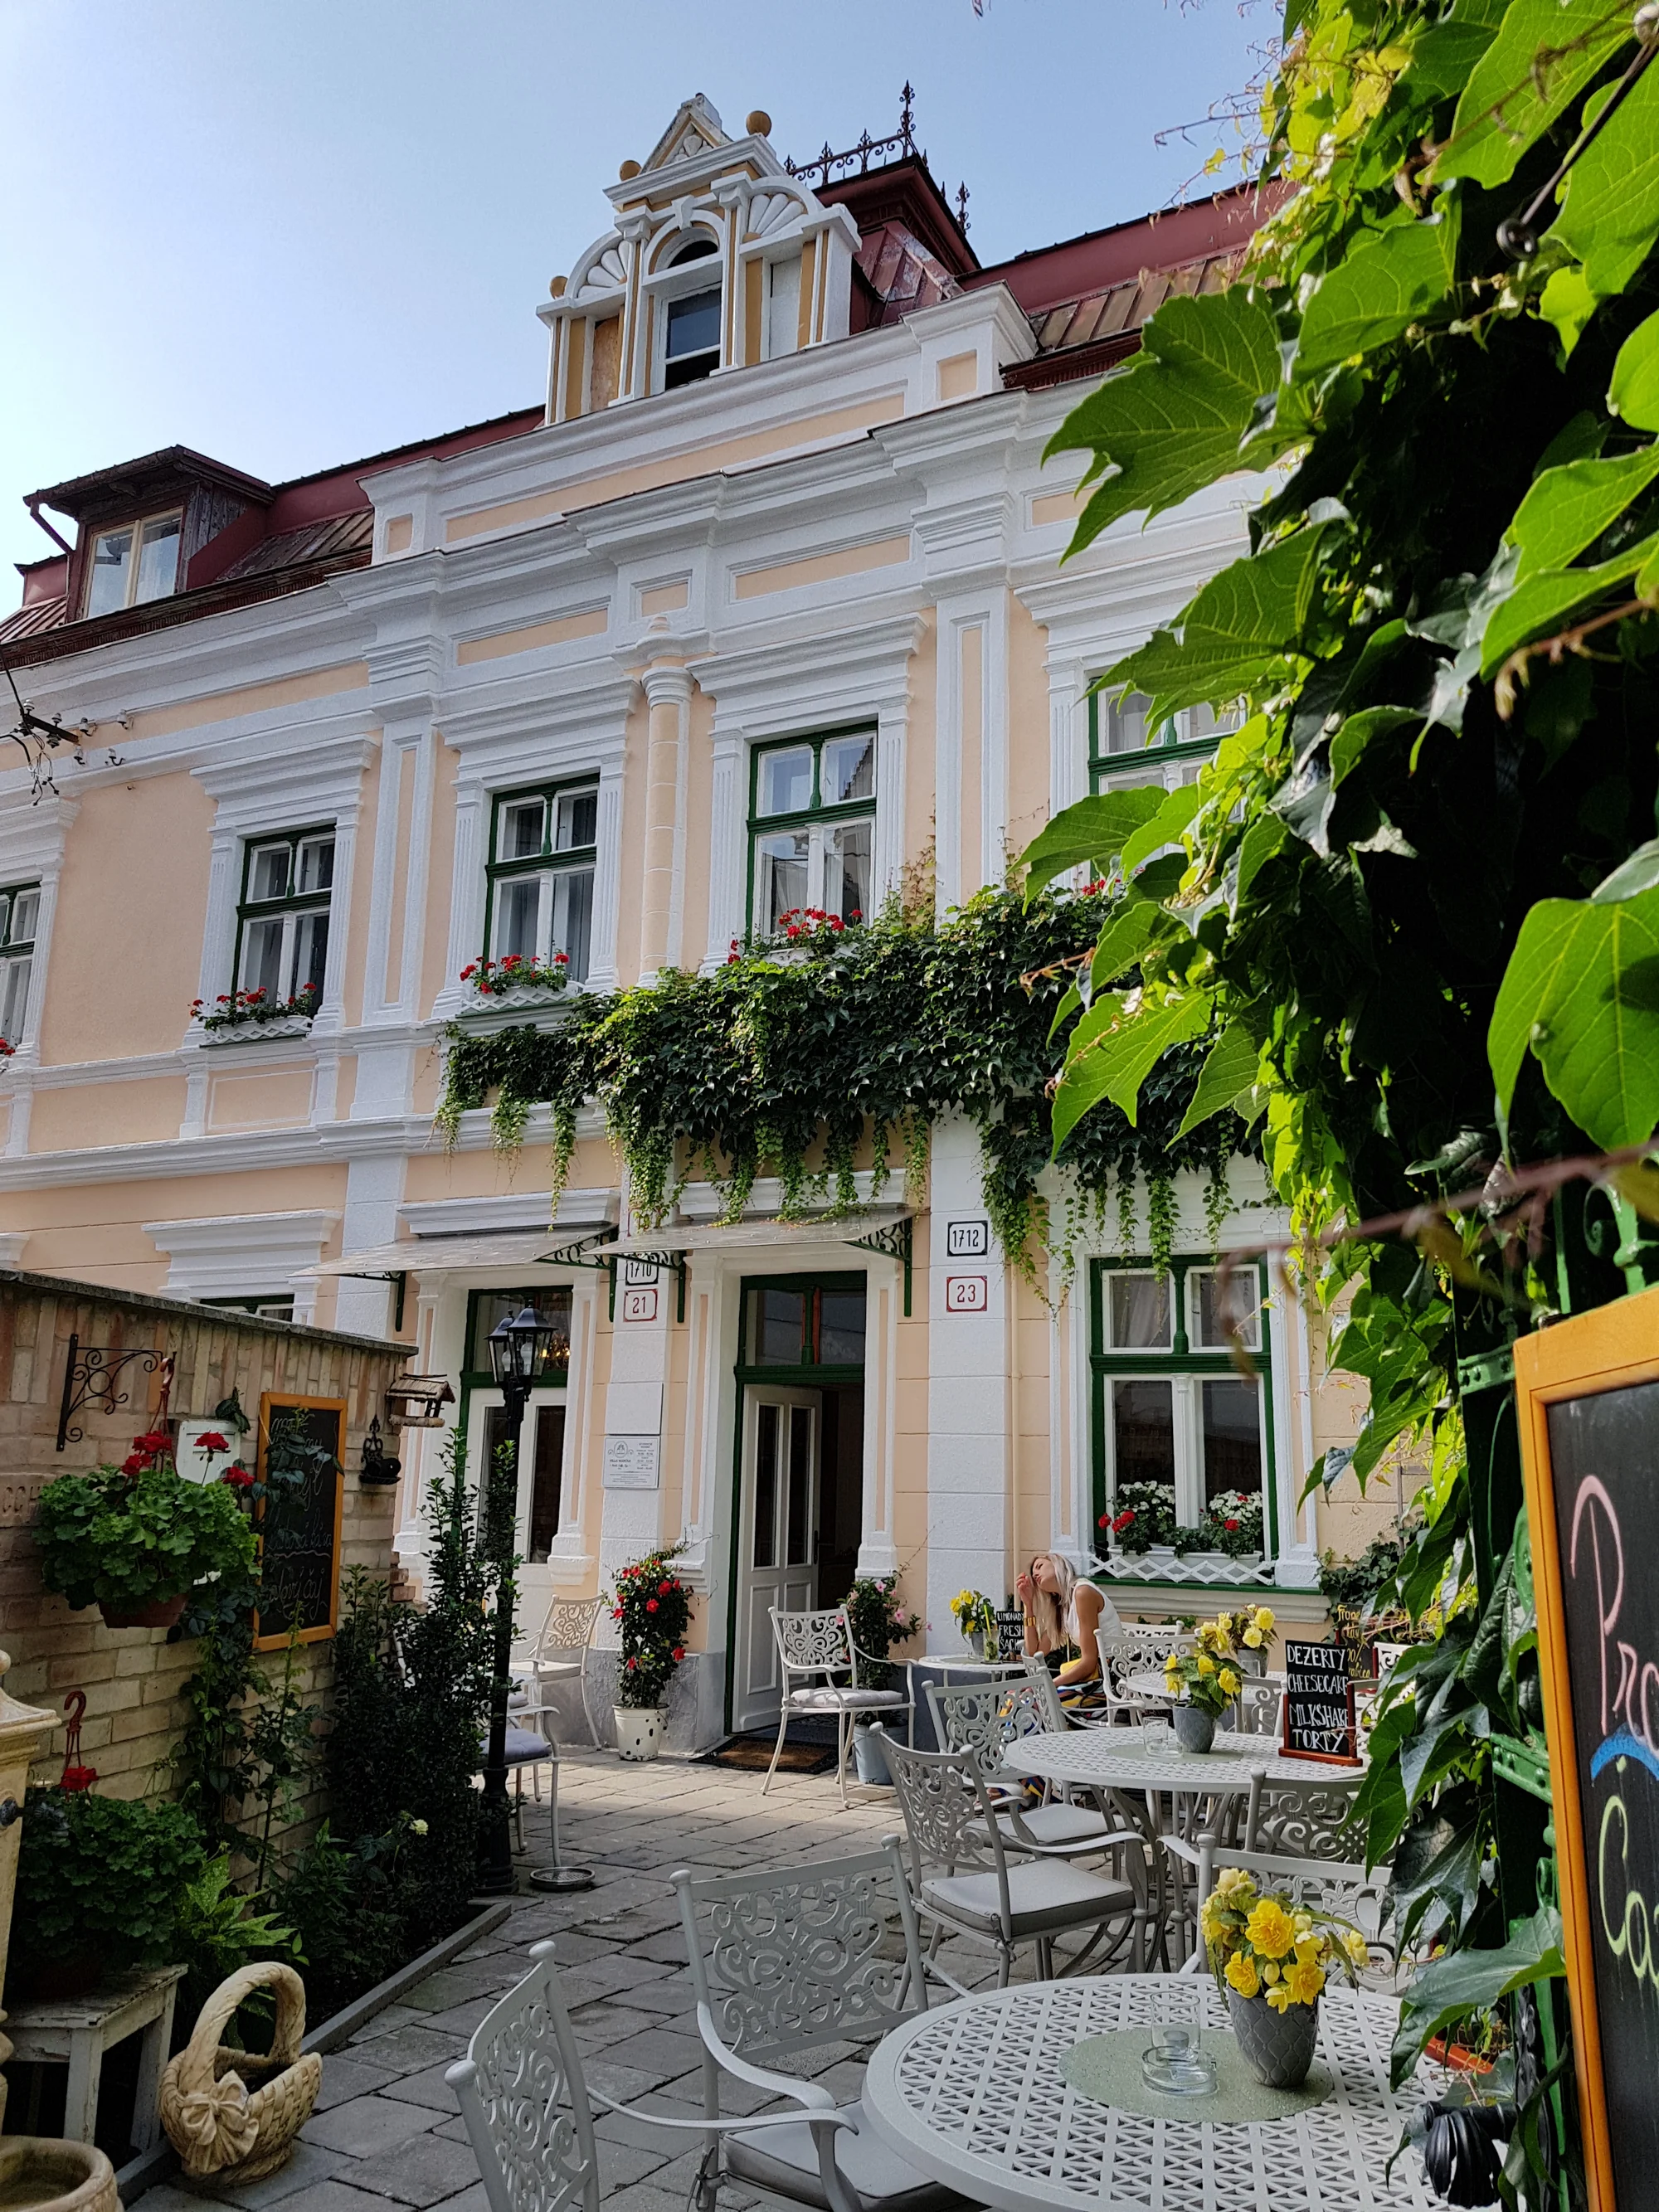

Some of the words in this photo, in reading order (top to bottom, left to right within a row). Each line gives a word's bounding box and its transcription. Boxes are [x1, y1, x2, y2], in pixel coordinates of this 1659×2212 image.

[952, 1229, 979, 1247] 1712
[956, 1284, 975, 1303] 23
[632, 1296, 646, 1314] 21
[999, 1624, 1024, 1637] FRESH
[1287, 1645, 1345, 1671] DEZERTY
[1287, 1674, 1349, 1695] CHEESECAKE
[1292, 1729, 1344, 1753] TORTY
